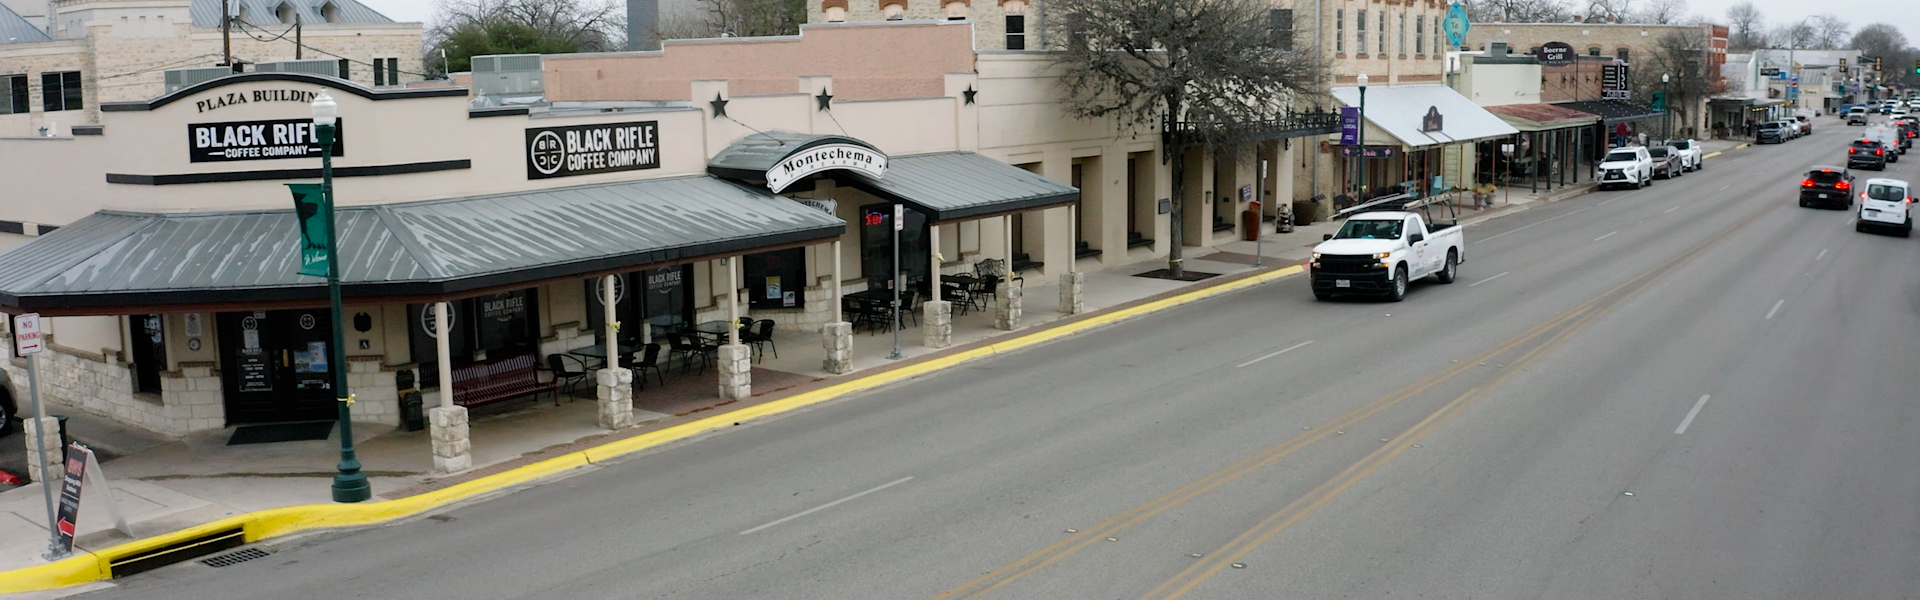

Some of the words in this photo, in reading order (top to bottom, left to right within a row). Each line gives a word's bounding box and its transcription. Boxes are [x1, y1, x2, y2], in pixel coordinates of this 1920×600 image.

[1543, 46, 1567, 54] Boerne
[196, 93, 247, 113] PLAZA
[253, 89, 319, 104] BUILDIN
[195, 125, 267, 148] BLACK
[272, 122, 336, 145] RIFL
[566, 128, 612, 153] BLACK
[615, 125, 655, 150] RIFLE
[225, 147, 261, 158] COFFEE
[262, 145, 308, 157] COMPANY
[567, 152, 606, 172] COFFEE
[608, 148, 655, 168] COMPANY
[782, 148, 873, 175] Montechema
[648, 273, 666, 285] BLACK
[666, 270, 682, 281] RIFLE
[483, 301, 505, 312] BLACK
[506, 296, 524, 308] RIFLE
[484, 309, 502, 318] COFFEE
[503, 306, 524, 316] COMPANY
[22, 320, 33, 329] NO
[18, 331, 40, 342] PARKING
